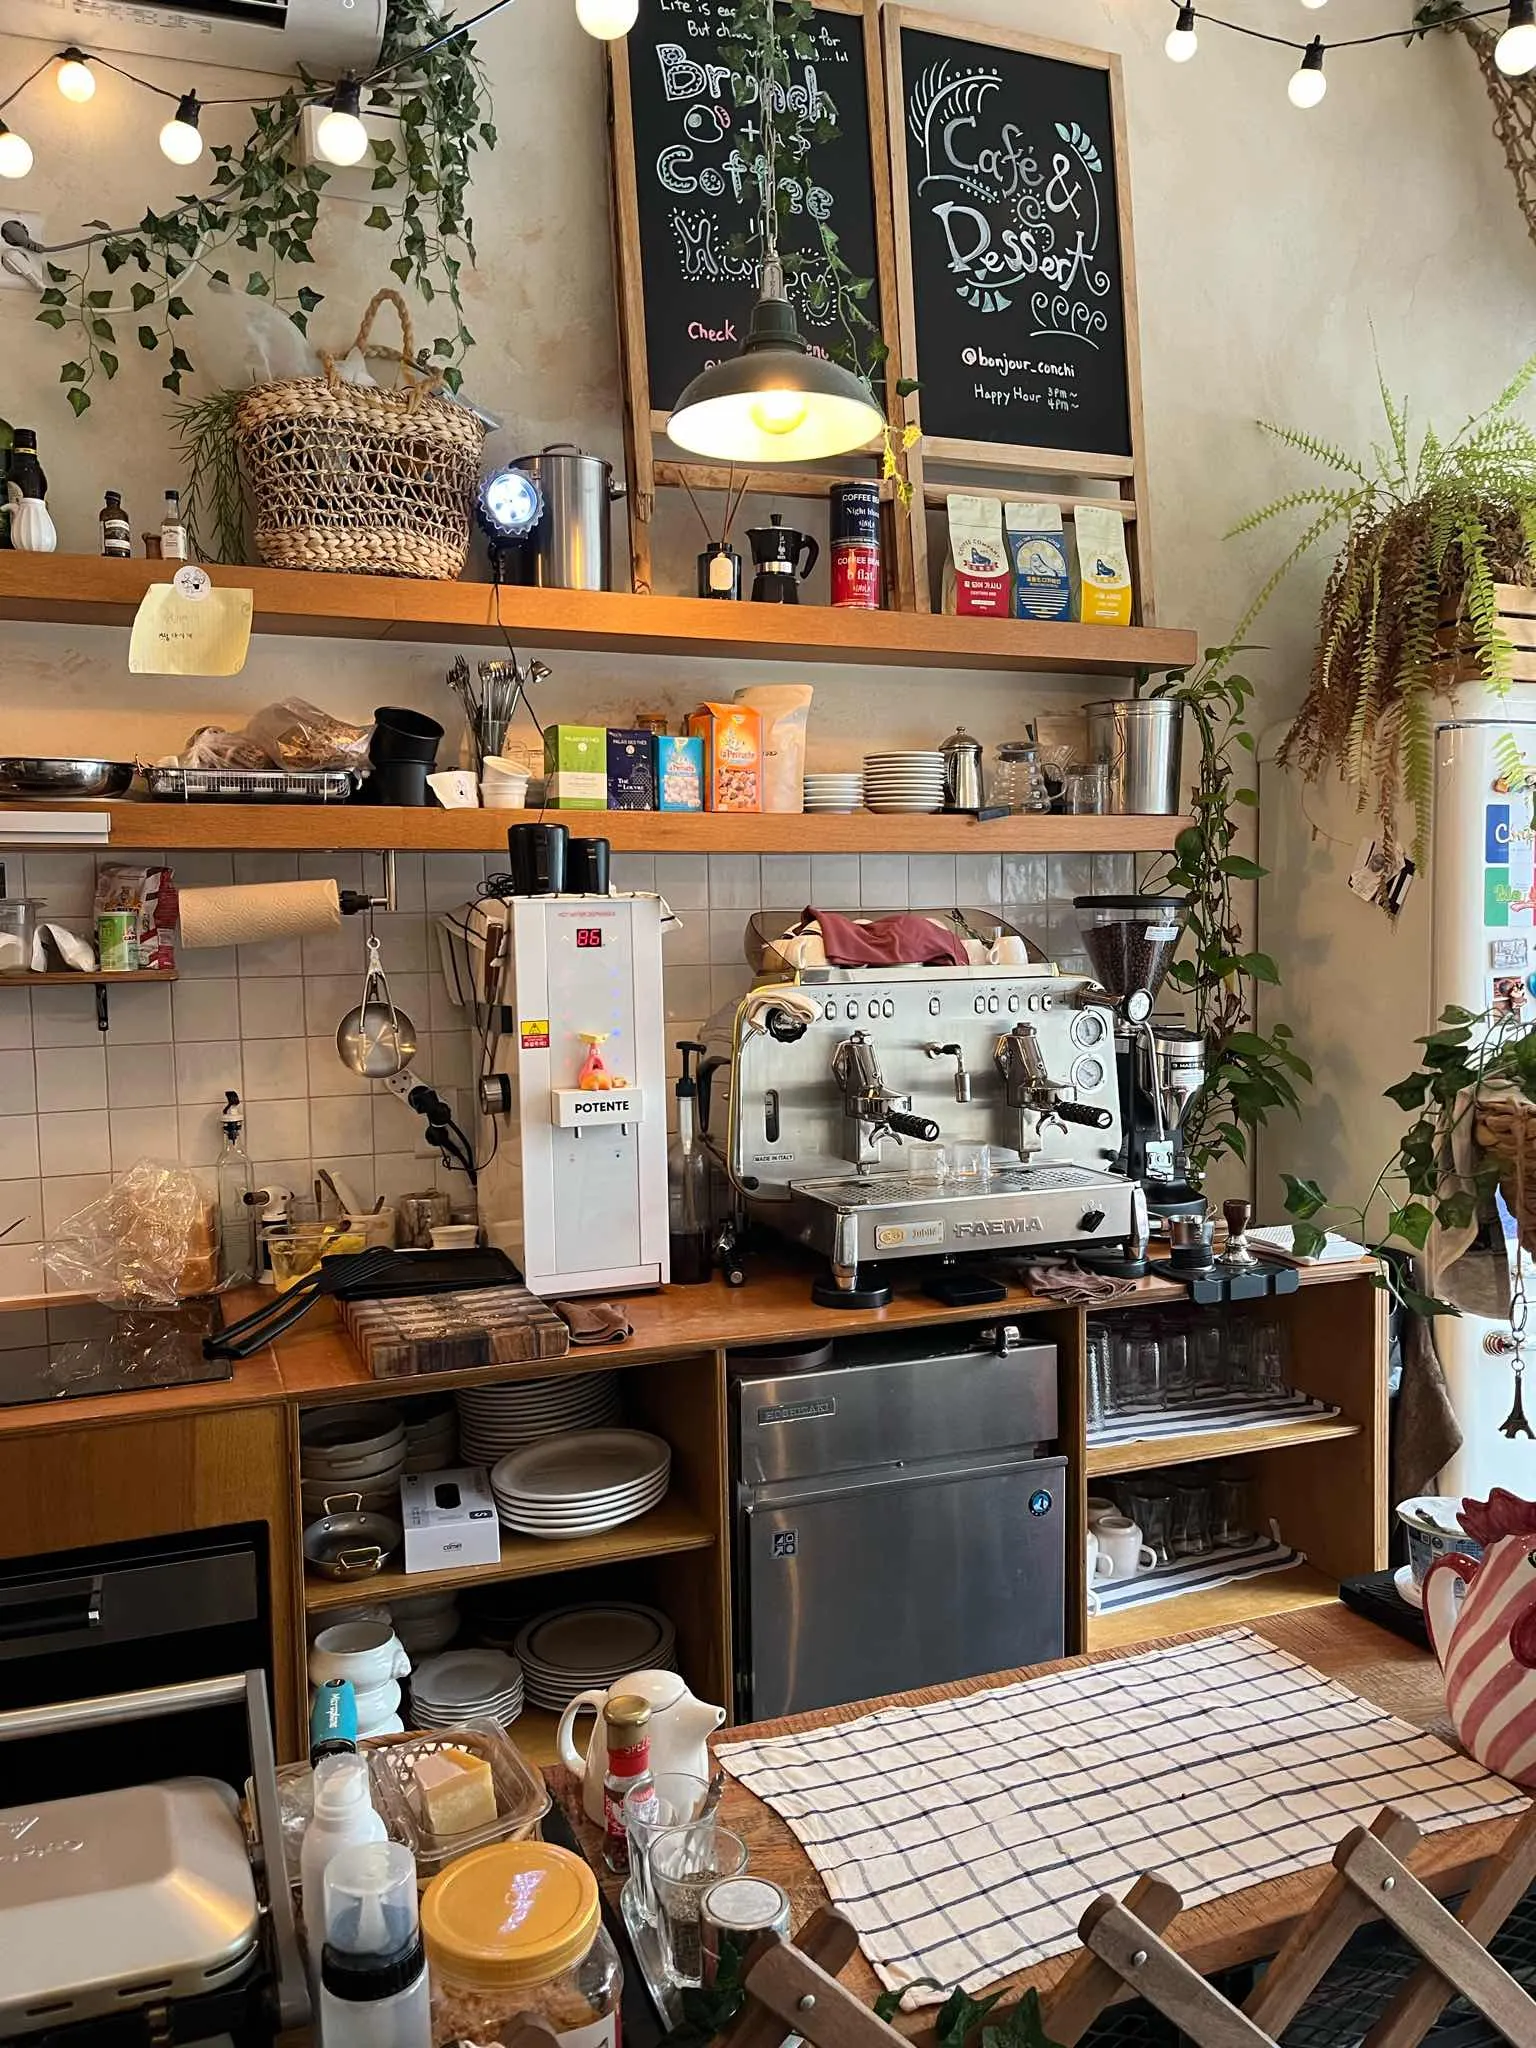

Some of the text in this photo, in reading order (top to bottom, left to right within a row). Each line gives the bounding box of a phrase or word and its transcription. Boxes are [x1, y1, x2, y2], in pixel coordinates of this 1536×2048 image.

[688, 20, 710, 38] But
[819, 27, 841, 47] for
[1046, 153, 1082, 220] &
[932, 200, 1111, 297] Dessert
[688, 319, 738, 343] Check
[961, 346, 1076, 377] @bonjour_conchi
[974, 383, 1011, 406] Happy
[1013, 386, 1042, 403] Hour
[842, 493, 872, 502] COFFEE
[846, 507, 866, 516] Night
[838, 556, 867, 566] COFFEE
[577, 930, 600, 946] 86
[574, 1100, 630, 1115] POTENTE
[953, 1216, 1044, 1239] FAEMA
